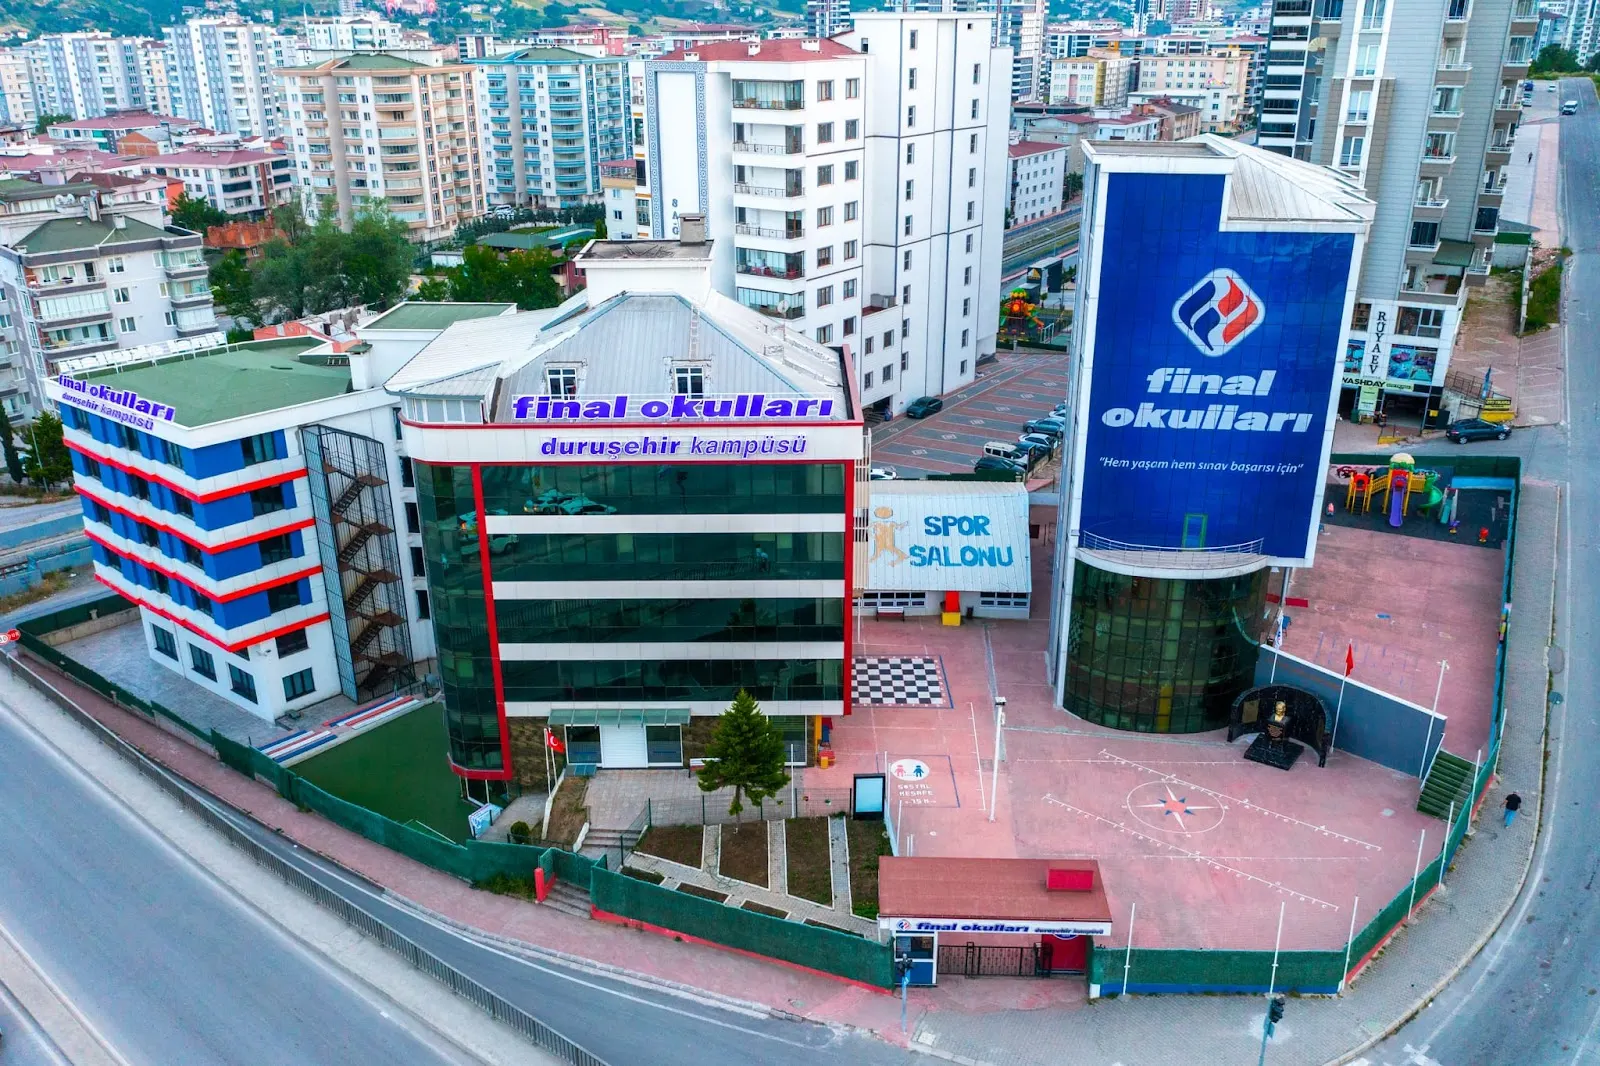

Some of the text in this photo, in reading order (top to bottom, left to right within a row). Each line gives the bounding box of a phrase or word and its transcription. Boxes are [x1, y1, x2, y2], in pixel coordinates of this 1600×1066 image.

[1146, 367, 1277, 396] final
[58, 374, 175, 421] final okulları
[512, 394, 834, 419] final okulları
[62, 392, 154, 431] duruşehir kampüsü
[1101, 402, 1313, 433] okulları
[541, 435, 807, 460] duruşehir kampüsü
[1131, 460, 1169, 471] yaşam
[1171, 459, 1196, 470] hem
[1197, 462, 1228, 471] sınav
[1230, 461, 1276, 474] başarısı
[924, 515, 991, 537] SPOR
[908, 544, 1013, 567] SALONU
[916, 922, 1030, 932] final okulları
